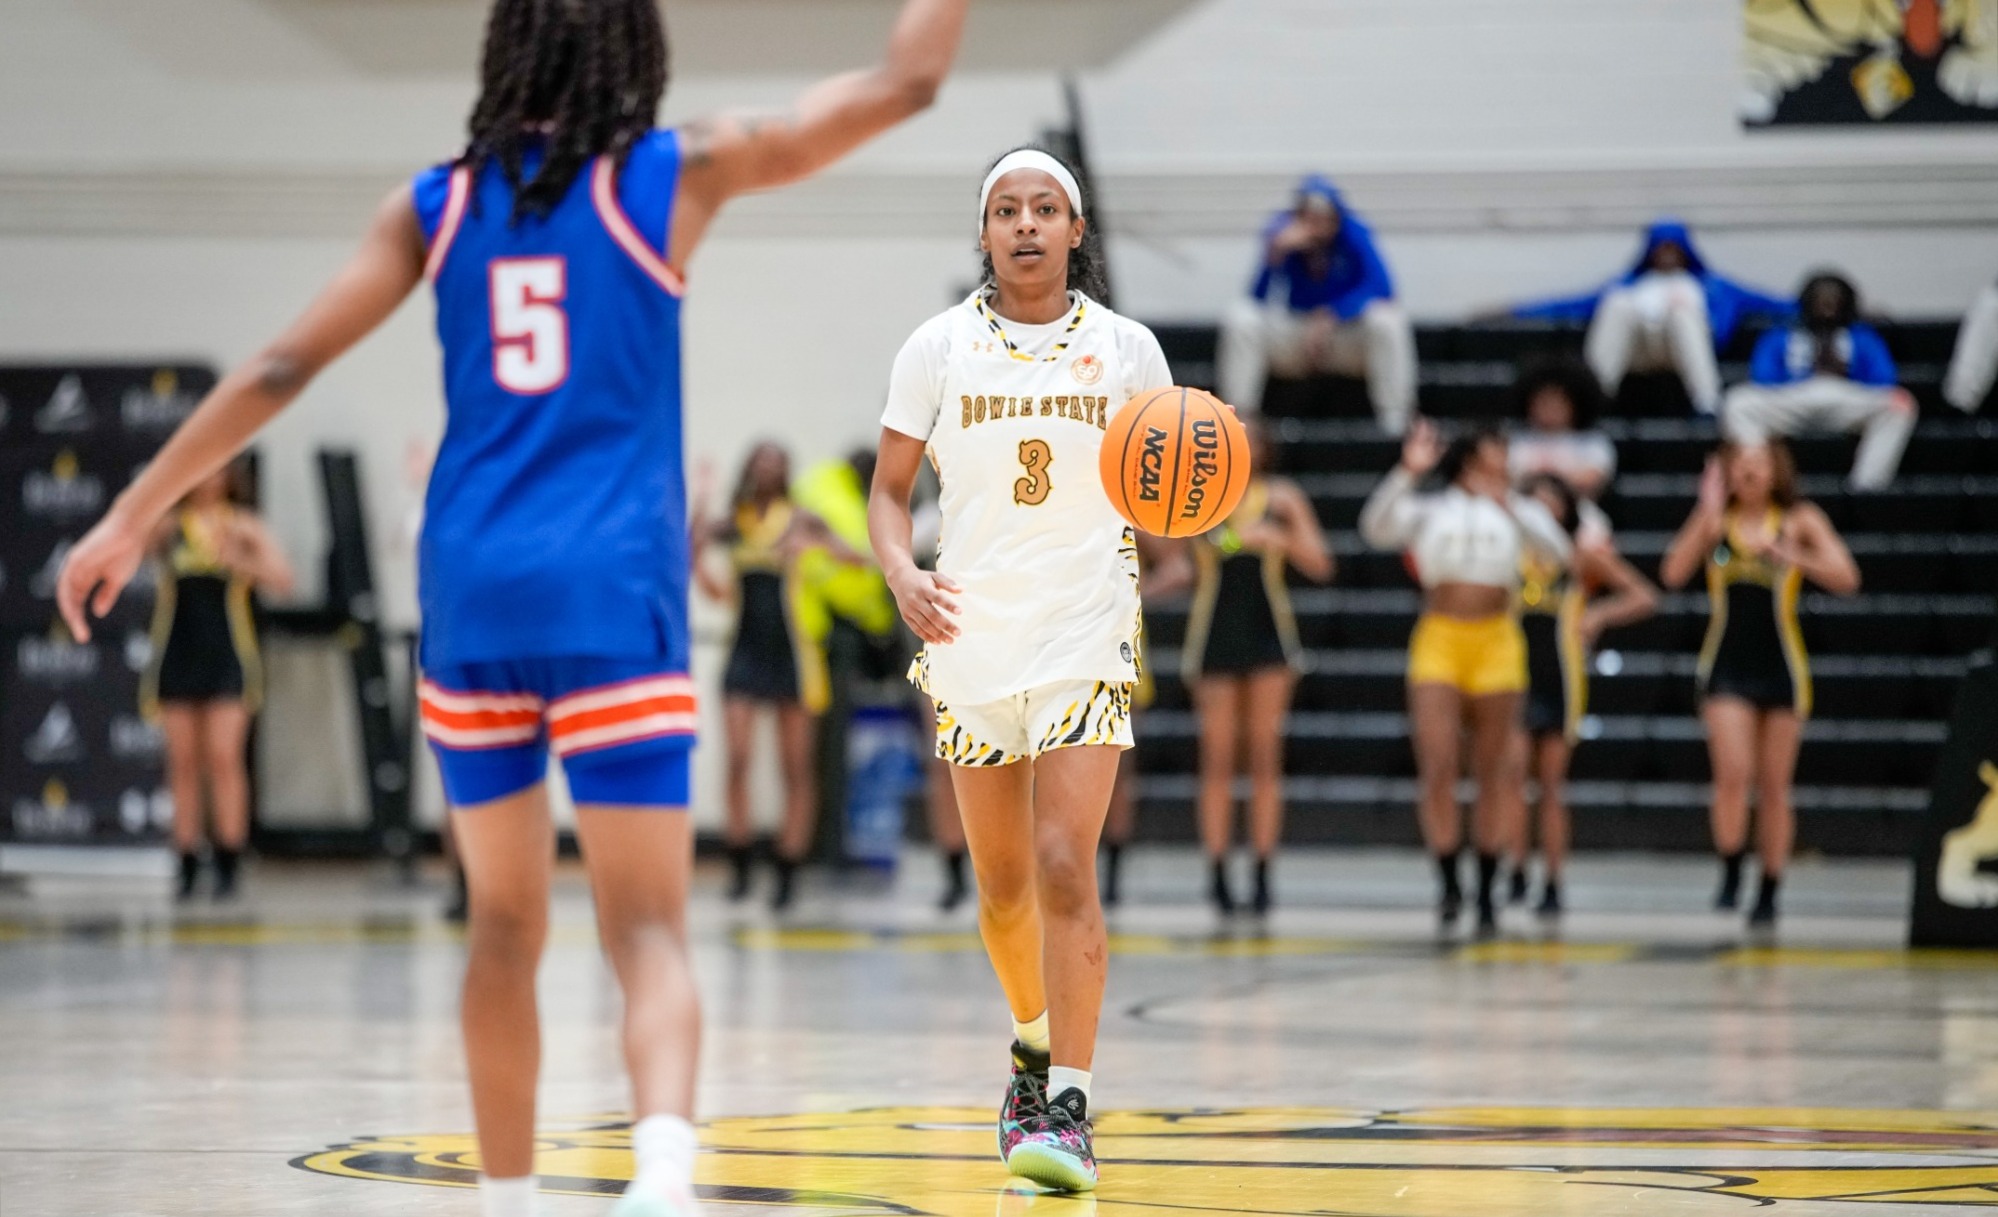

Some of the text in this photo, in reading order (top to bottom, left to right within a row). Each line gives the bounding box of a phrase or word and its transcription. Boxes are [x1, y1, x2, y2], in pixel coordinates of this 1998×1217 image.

[488, 255, 570, 396] 5
[961, 395, 1107, 430] BOWIE STATE
[1014, 438, 1052, 505] 3
[1139, 425, 1169, 502] NCAA
[1180, 418, 1218, 519] Wilson
